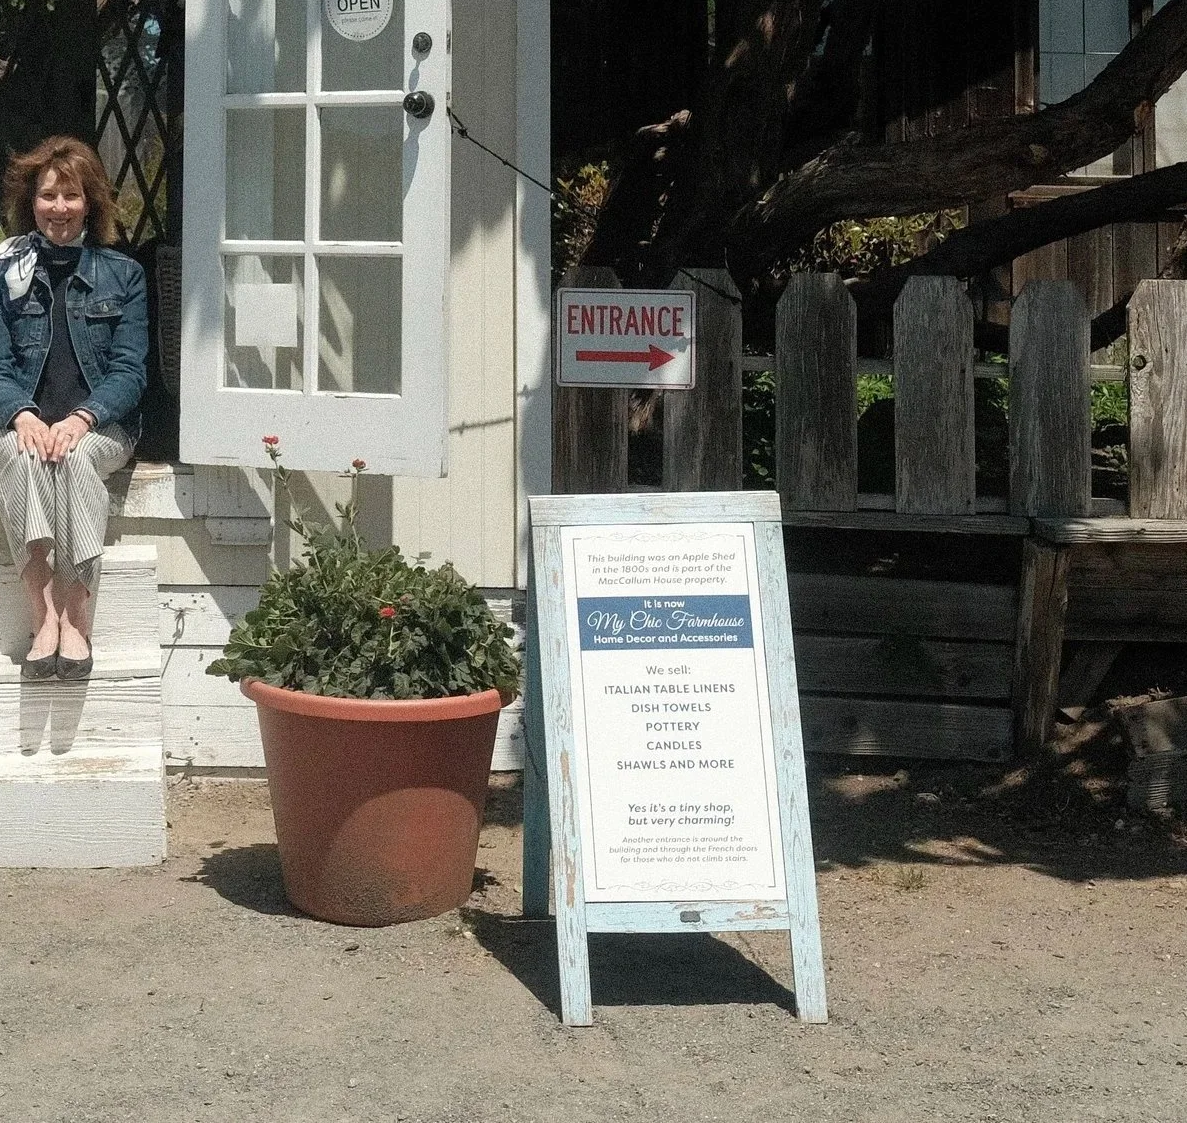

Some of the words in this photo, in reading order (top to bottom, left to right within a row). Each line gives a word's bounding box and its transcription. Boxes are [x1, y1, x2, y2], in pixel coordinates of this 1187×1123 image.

[567, 304, 685, 337] ENTRANCE
[587, 554, 605, 563] This
[607, 554, 645, 563] building
[682, 553, 710, 563] Apple
[712, 552, 735, 560] Shed
[592, 566, 601, 574] in
[622, 565, 649, 573] 1800s
[681, 565, 702, 574] part
[598, 577, 651, 585] MacCallum
[684, 576, 727, 585] property.
[644, 600, 652, 608] It
[654, 600, 662, 608] is
[664, 600, 685, 608] now
[587, 611, 625, 635] My
[630, 610, 662, 630] Chic
[666, 610, 744, 630] Farmhouse
[594, 635, 624, 644] Home
[626, 634, 656, 643] Decor
[658, 634, 677, 643] and
[679, 633, 738, 642] Accessories
[646, 666, 664, 675] We
[668, 665, 691, 675] sell:
[604, 685, 650, 694] ITALIAN
[654, 684, 689, 694] TABLE
[693, 684, 735, 693] LINENS
[631, 704, 659, 713] DISH
[662, 703, 711, 712] TOWELS
[646, 722, 700, 731] POTTERY
[647, 741, 702, 750] CANDLES
[617, 760, 666, 769] SHAWLS
[669, 760, 695, 769] AND
[699, 759, 734, 769] MORE
[628, 804, 647, 813] Yes
[650, 803, 666, 812] it's
[680, 803, 701, 813] tiny
[704, 803, 733, 813] shop,
[628, 816, 647, 825] but
[651, 818, 675, 827] very
[678, 815, 735, 827] charming!
[622, 836, 653, 844] Another
[609, 846, 641, 854] building
[660, 846, 691, 854] through
